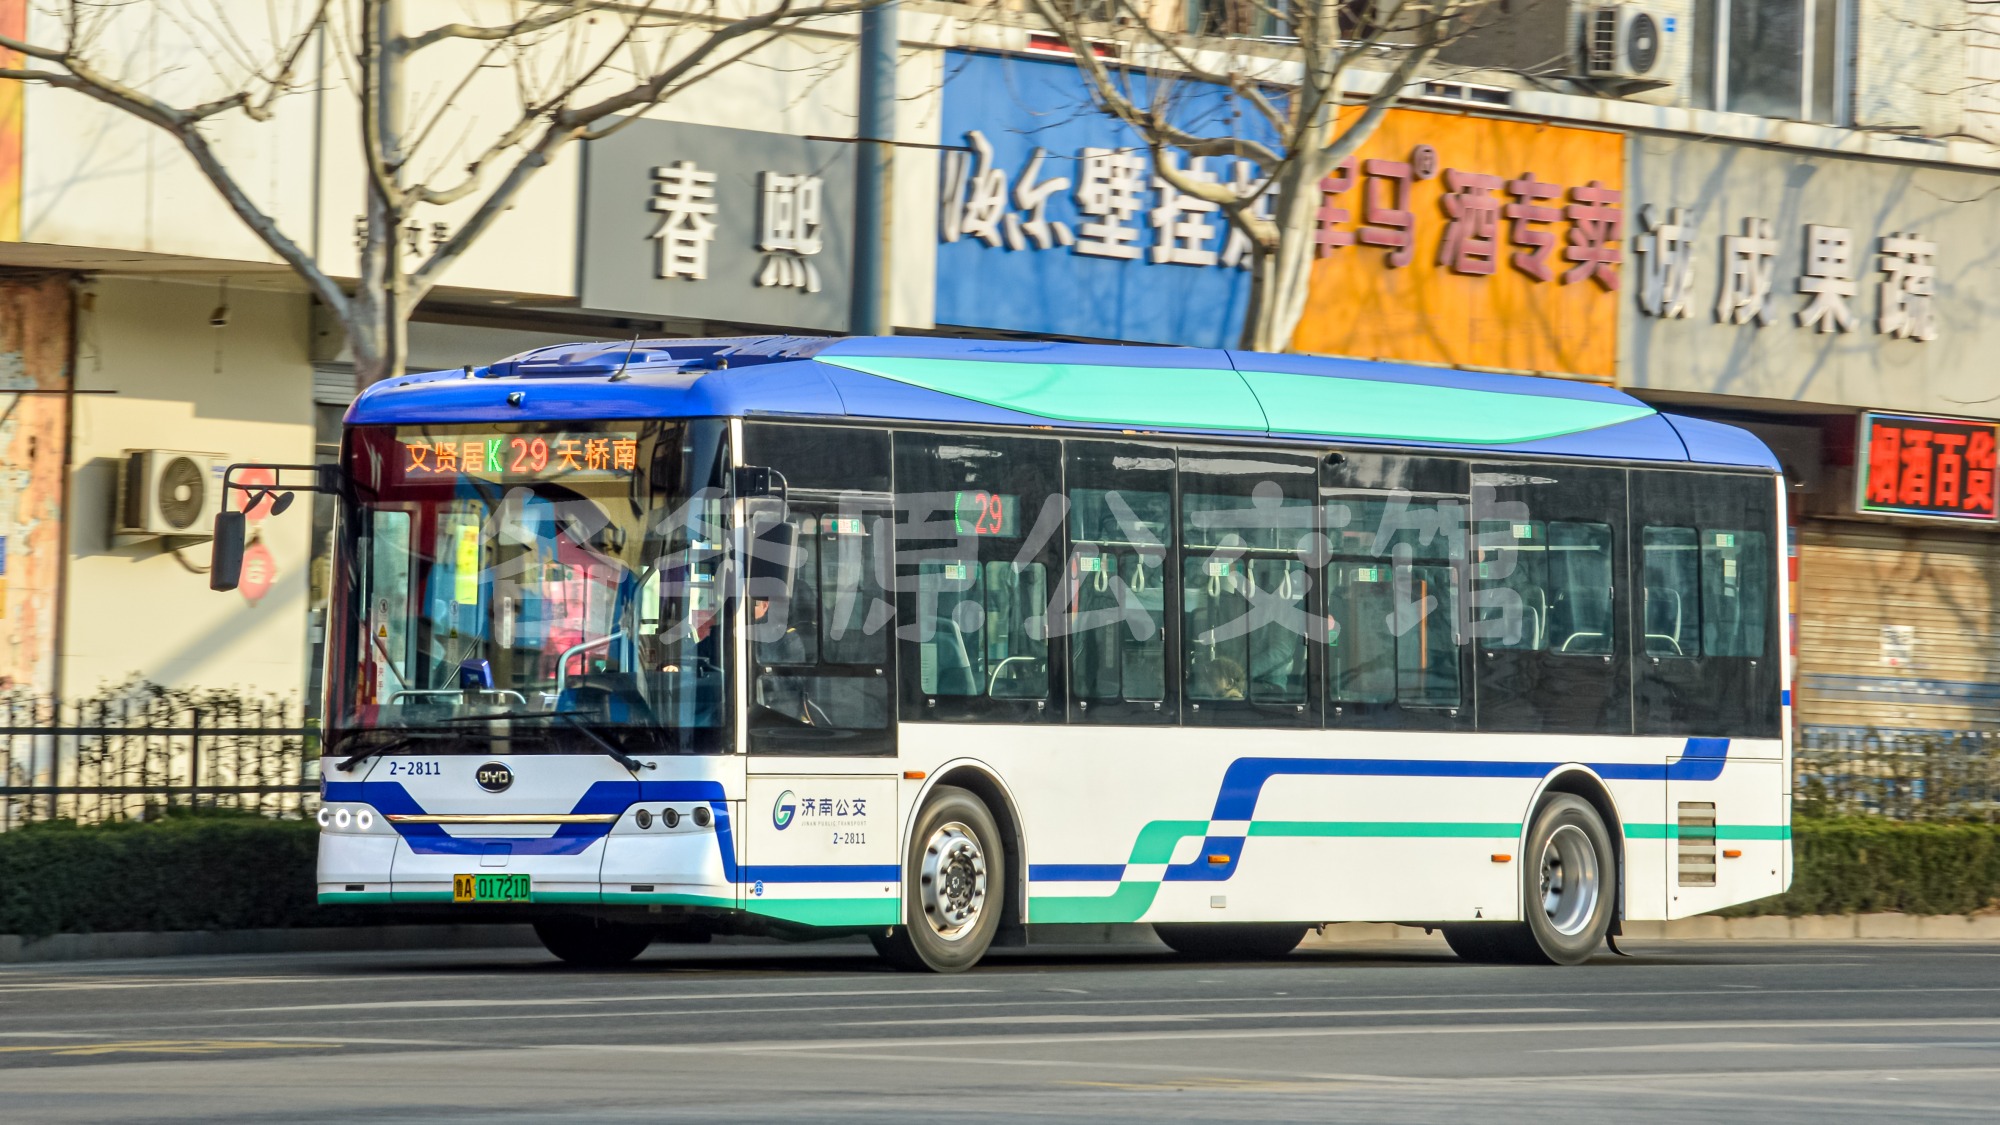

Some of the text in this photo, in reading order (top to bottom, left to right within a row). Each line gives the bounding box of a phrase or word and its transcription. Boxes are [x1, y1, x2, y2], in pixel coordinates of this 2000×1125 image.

[653, 160, 824, 292] 春熙
[1636, 203, 1938, 341] 诚成果蔬
[557, 437, 638, 471] 天桥南
[1866, 423, 1997, 510] 烟酒百货
[389, 761, 441, 776] 2-2811
[479, 770, 509, 784] BYD
[801, 797, 867, 817] 济南公交
[832, 832, 866, 845] 2-2811
